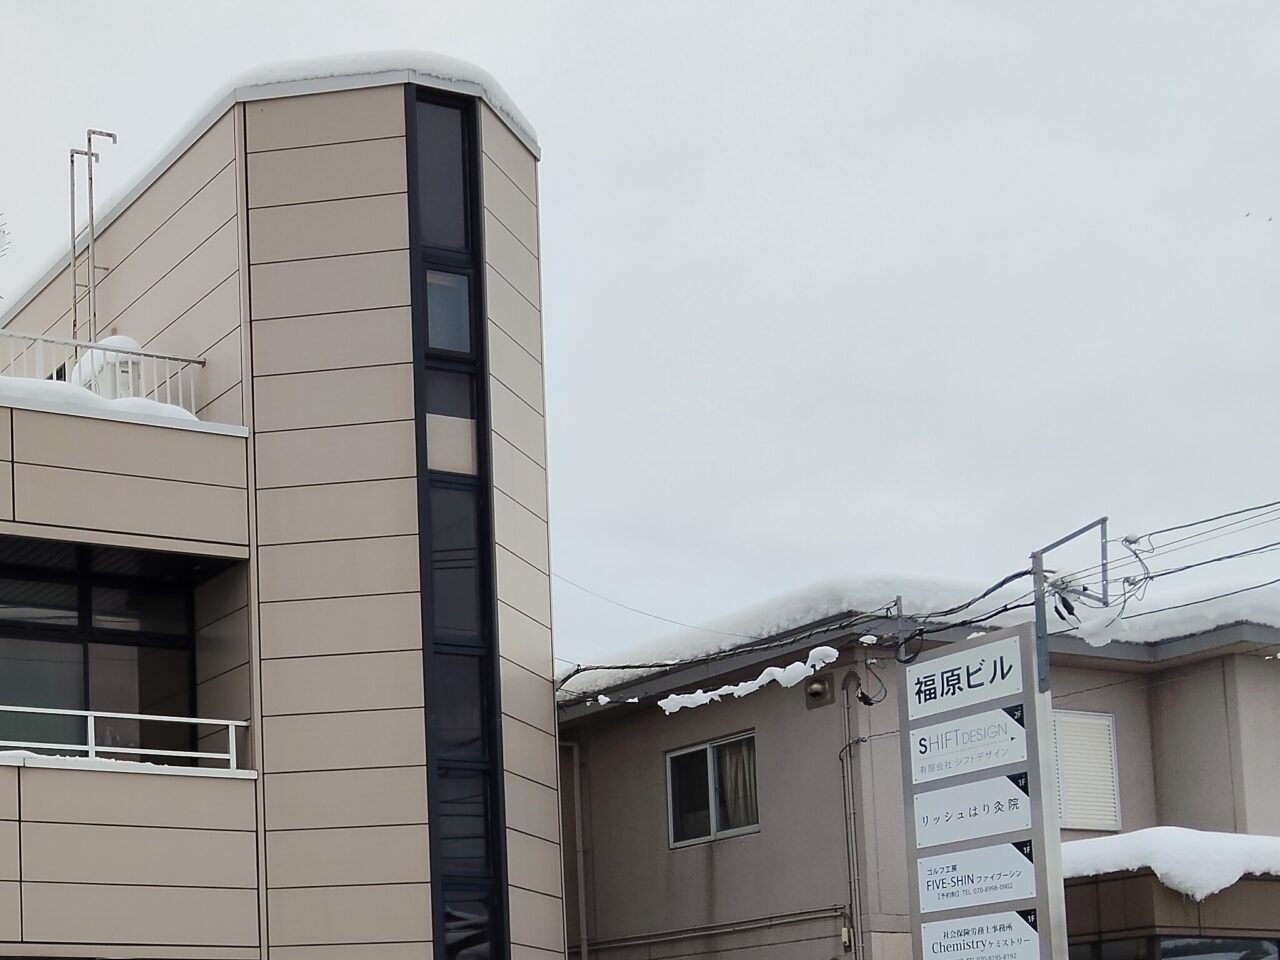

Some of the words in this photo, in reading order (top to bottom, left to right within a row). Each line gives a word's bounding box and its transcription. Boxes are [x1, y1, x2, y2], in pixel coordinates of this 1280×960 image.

[914, 655, 1013, 704] 福原ビル
[1014, 710, 1022, 719] 2F
[920, 760, 952, 774] 有限会社
[1018, 778, 1026, 787] 1F
[922, 798, 1020, 827] リッシュはり灸院
[1023, 846, 1031, 854] 1F
[926, 874, 974, 891] FIVE-SHIN
[1027, 915, 1035, 923] 1F
[931, 939, 988, 954] Chemistry
[987, 937, 1031, 949] ケミストリー
